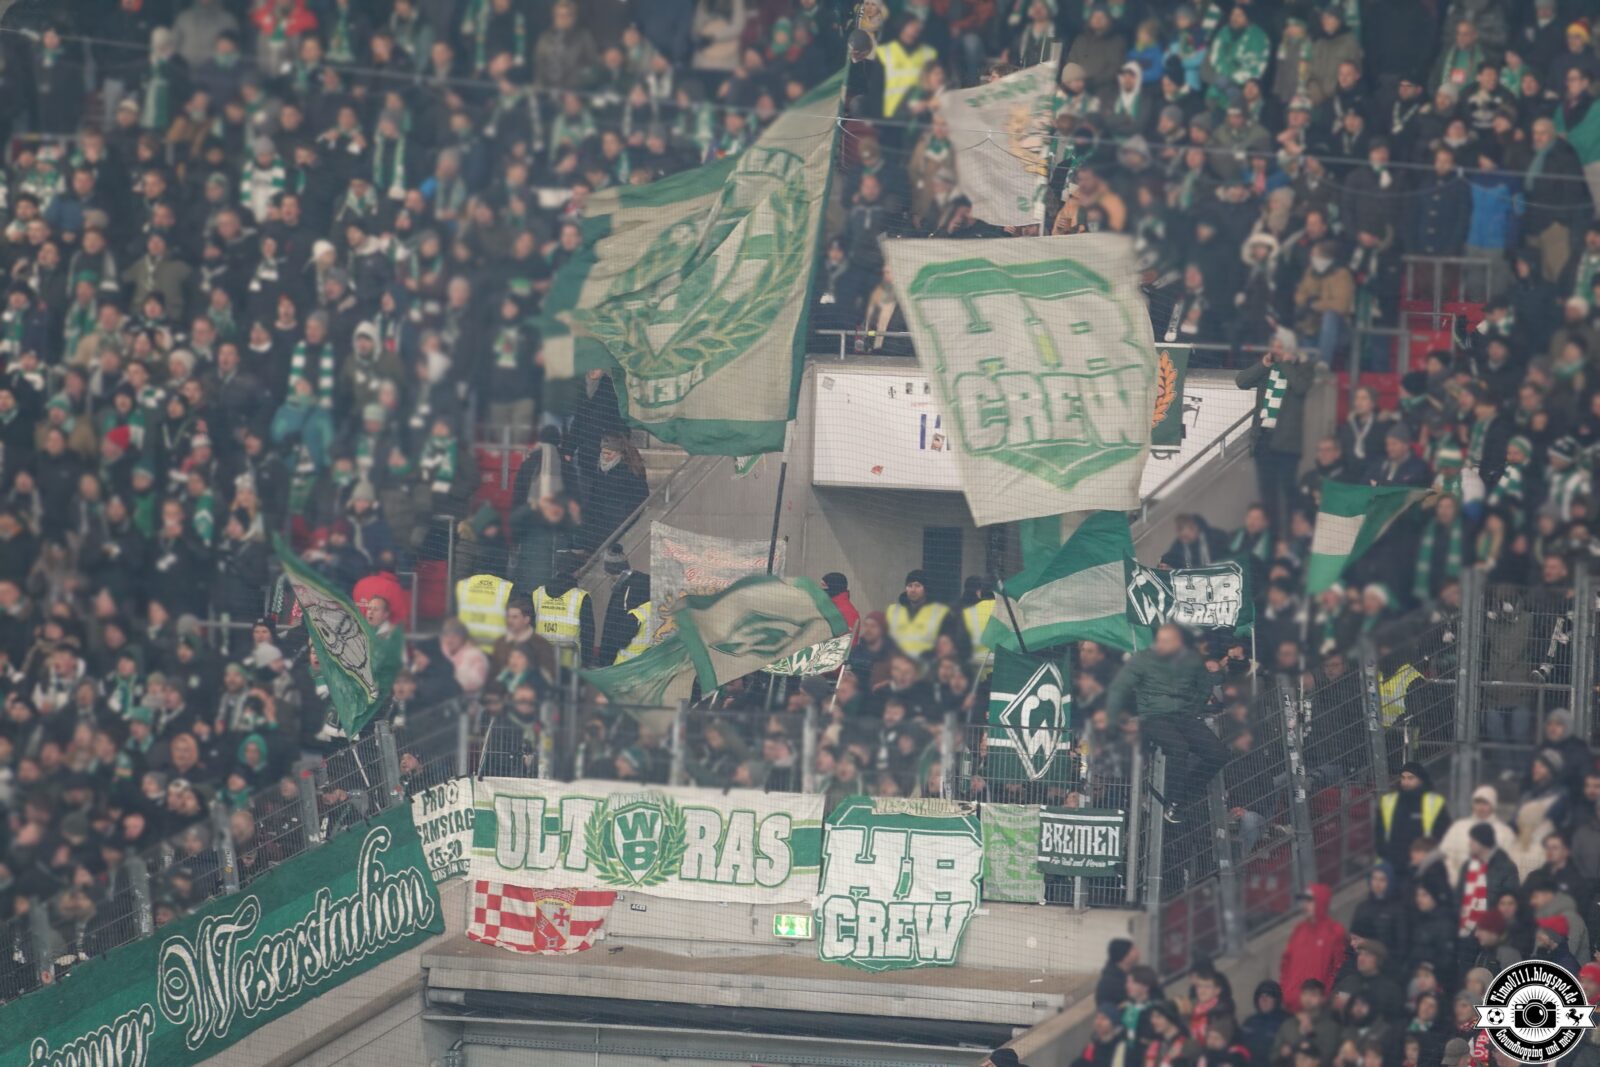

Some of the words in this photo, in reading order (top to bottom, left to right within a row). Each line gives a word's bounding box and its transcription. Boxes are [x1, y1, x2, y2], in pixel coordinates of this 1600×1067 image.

[953, 369, 1148, 454] CREW
[1175, 599, 1238, 625] CREW
[421, 785, 446, 816] PRO
[820, 826, 983, 901] HB
[1041, 822, 1120, 857] BREMEN
[158, 827, 434, 1049] Weserstadion
[820, 894, 973, 965] CREW
